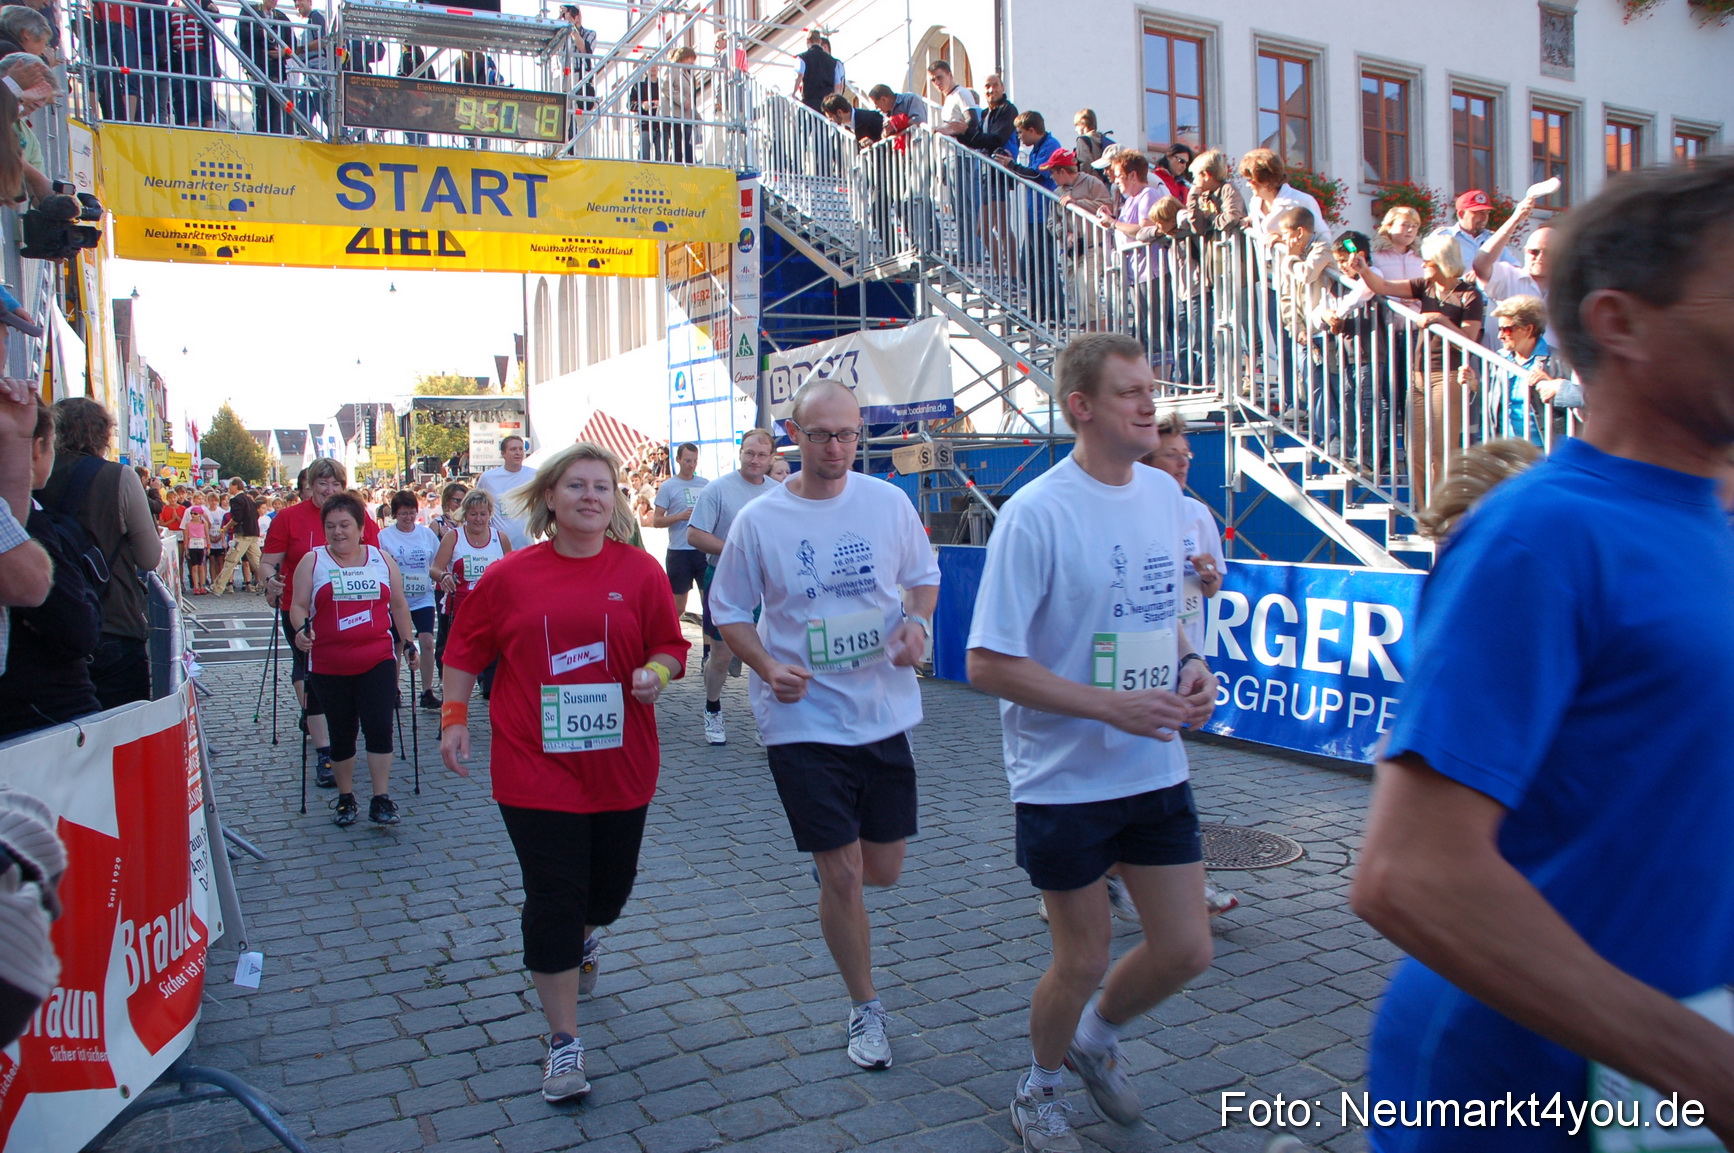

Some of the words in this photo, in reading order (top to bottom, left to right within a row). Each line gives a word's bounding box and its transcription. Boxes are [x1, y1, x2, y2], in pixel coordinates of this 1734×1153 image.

[350, 76, 400, 89] SPORTRONIC
[416, 83, 466, 95] Elektronische
[144, 175, 228, 191] Neumarkter
[232, 181, 296, 196] Stadtlauf
[336, 162, 548, 218] START
[586, 202, 653, 216] Neumarkter
[655, 204, 706, 219] Stadtlauf
[144, 228, 217, 241] Neumarkter
[220, 231, 275, 243] Stadtlauf
[530, 243, 588, 254] Neumarkter
[590, 245, 634, 256] Stadtlauf
[179, 471, 187, 480] A
[357, 471, 364, 480] A
[346, 579, 377, 591] 5062
[405, 583, 426, 591] 5126
[833, 629, 880, 656] 5183
[566, 650, 590, 666] DEHN
[1122, 664, 1170, 691] 5182
[563, 691, 608, 704] Susanne
[566, 713, 618, 733] 5045
[112, 857, 121, 883] 1929
[158, 971, 189, 999] Sicher
[182, 961, 201, 978] ist
[50, 1046, 77, 1062] Sicher
